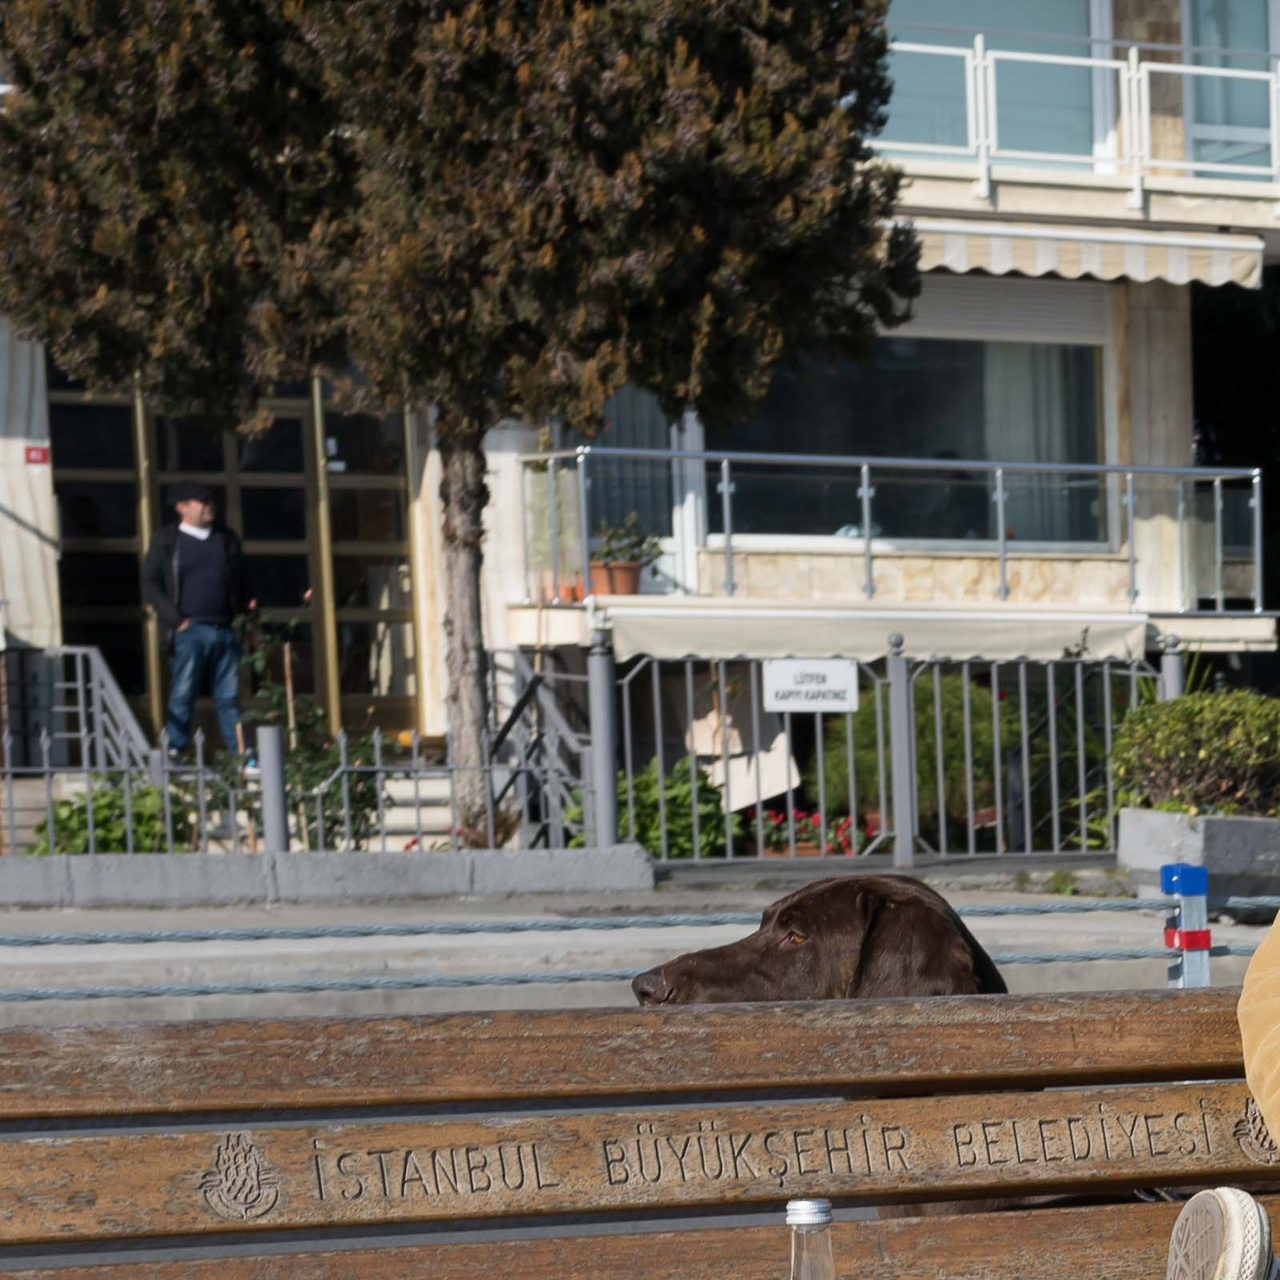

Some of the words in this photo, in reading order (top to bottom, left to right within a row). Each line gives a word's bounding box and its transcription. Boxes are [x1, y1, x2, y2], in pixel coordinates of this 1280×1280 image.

[313, 1138, 560, 1201] İSTANBUL
[602, 1114, 909, 1188] BÜYÜKŞEHİR
[953, 1098, 1212, 1167] BELEDİYESİ
